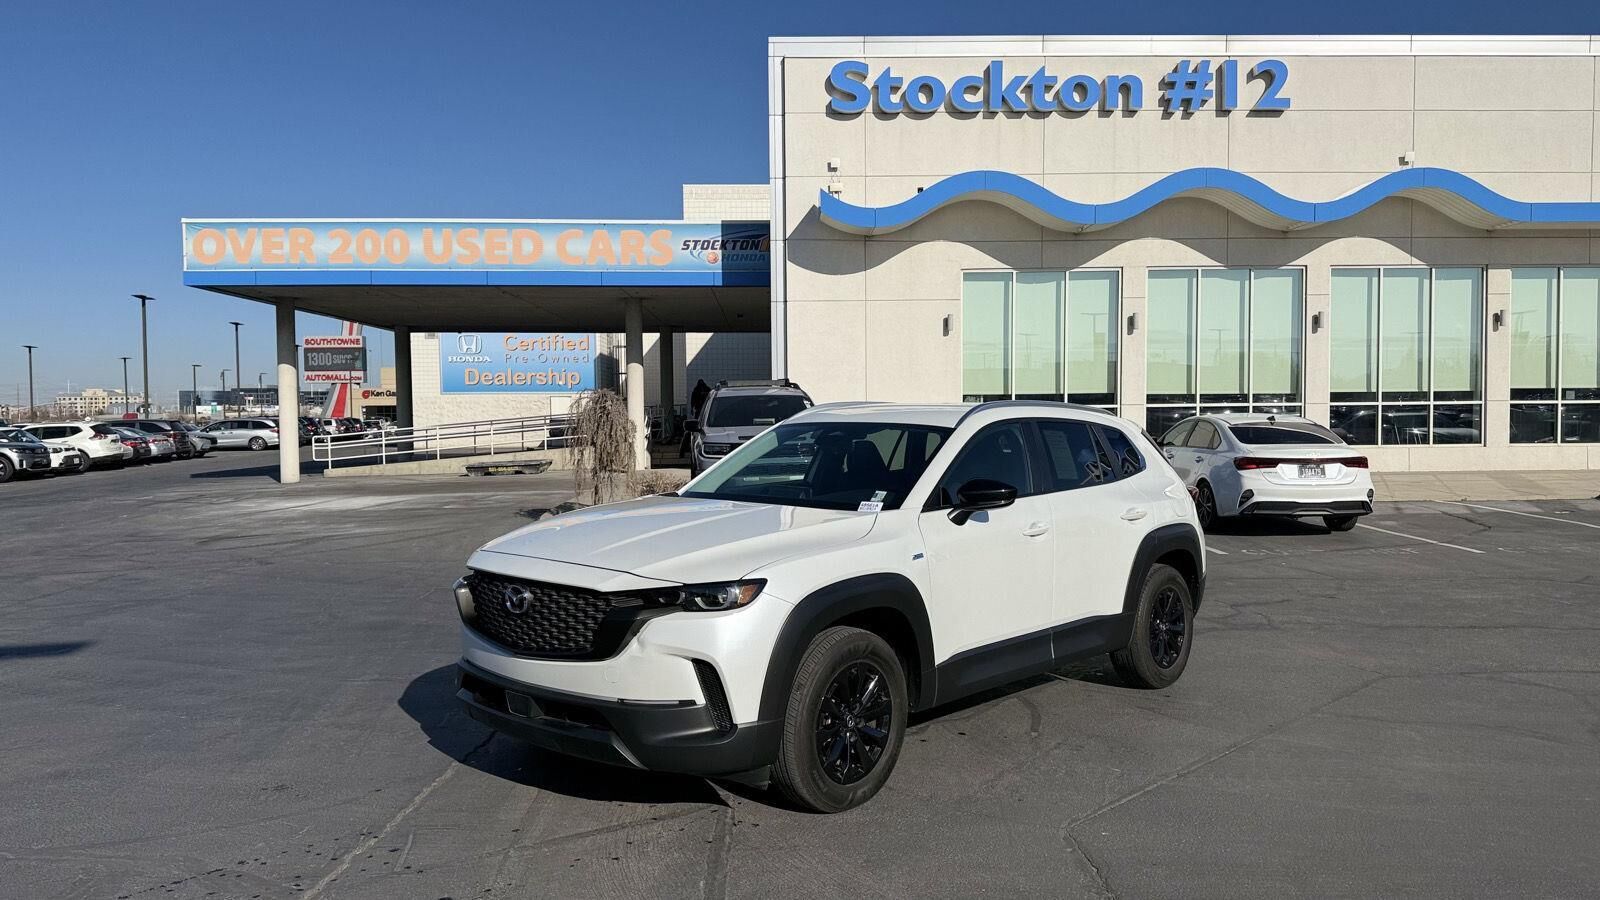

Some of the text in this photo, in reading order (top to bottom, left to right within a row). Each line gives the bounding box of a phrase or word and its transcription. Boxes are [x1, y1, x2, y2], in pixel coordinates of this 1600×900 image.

[827, 59, 1291, 115] Stockton #12
[192, 227, 674, 266] OVER 200 USED CARS
[681, 239, 762, 251] STOCKTON
[304, 338, 361, 346] SOUTHTOWNE
[503, 334, 590, 351] Certified
[307, 352, 332, 366] 1300
[448, 355, 493, 364] HONDA
[505, 353, 590, 364] Pre-Owned
[464, 368, 581, 389] Dealership
[370, 390, 385, 398] Ken
